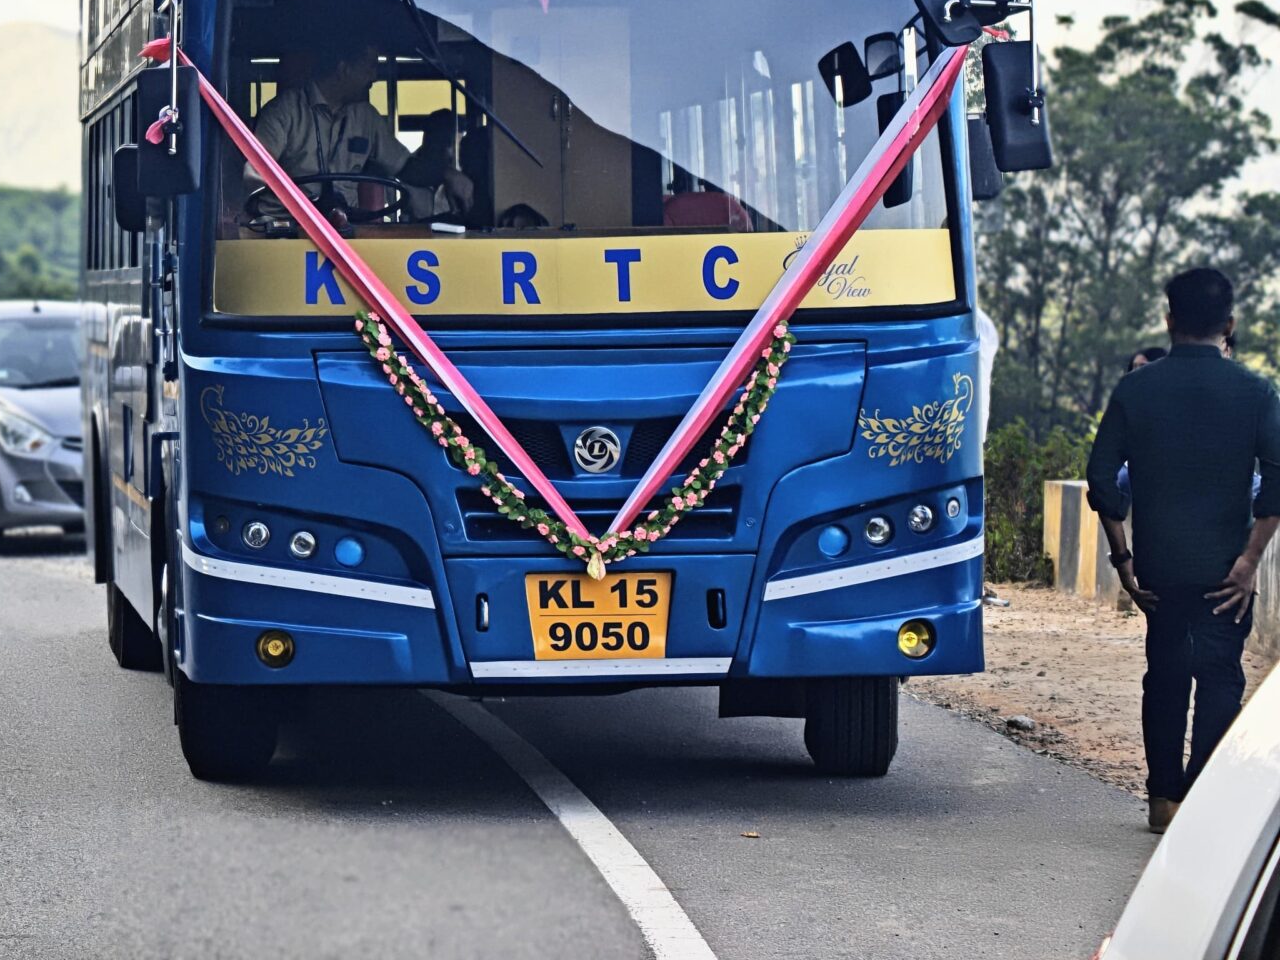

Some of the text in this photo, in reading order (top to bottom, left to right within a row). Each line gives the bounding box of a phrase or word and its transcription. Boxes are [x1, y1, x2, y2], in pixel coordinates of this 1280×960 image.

[826, 276, 872, 301] View
[538, 578, 659, 609] KL 15
[548, 621, 650, 652] 9050
